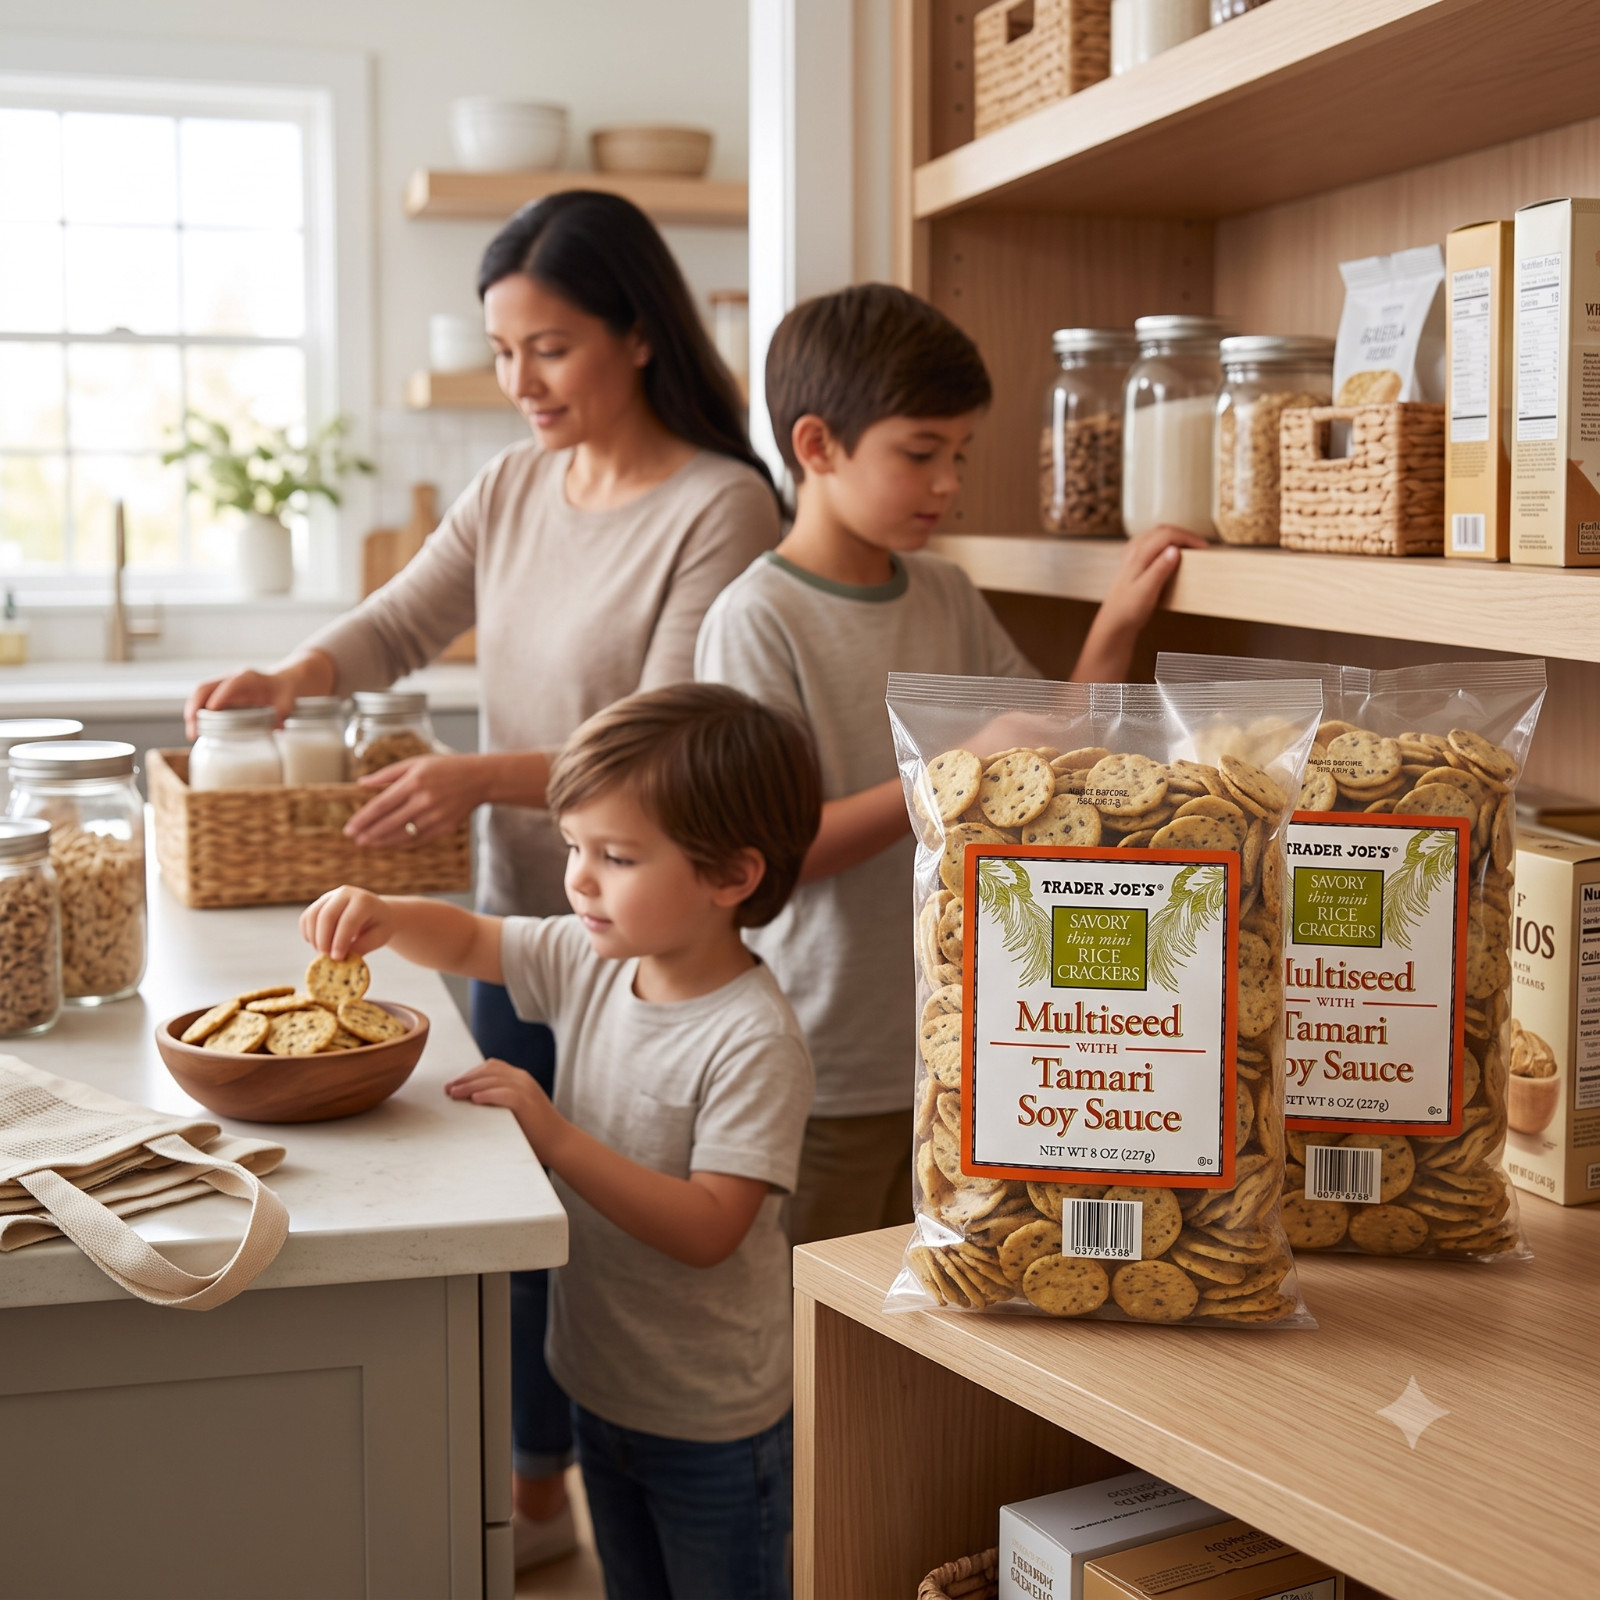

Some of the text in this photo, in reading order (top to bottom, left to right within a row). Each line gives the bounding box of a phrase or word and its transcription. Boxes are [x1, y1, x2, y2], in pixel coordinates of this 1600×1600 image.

[1041, 880, 1105, 896] TRADER
[1310, 874, 1367, 890] SAVORY
[1307, 890, 1369, 906] thin mini
[1069, 913, 1131, 931] SAVORY
[1317, 906, 1359, 922] RICE
[1066, 932, 1132, 946] thin mini
[1298, 922, 1376, 939] CRACKERS
[1077, 948, 1122, 964] RICE
[1057, 964, 1140, 982] CRACKERS
[1316, 996, 1355, 1008] WITH
[1014, 1000, 1184, 1038] Multiseed
[1075, 1041, 1119, 1055] WITH
[1031, 1055, 1155, 1093] Tamari
[1323, 1049, 1415, 1084] Sauce
[1306, 1096, 1327, 1107] WT
[1327, 1097, 1335, 1107] 8
[1336, 1097, 1355, 1109] OZ
[1356, 1098, 1390, 1113] (227g)
[1017, 1093, 1183, 1138] Soy Sauce
[1039, 1145, 1156, 1163] NET WT 8 OZ (227g)
